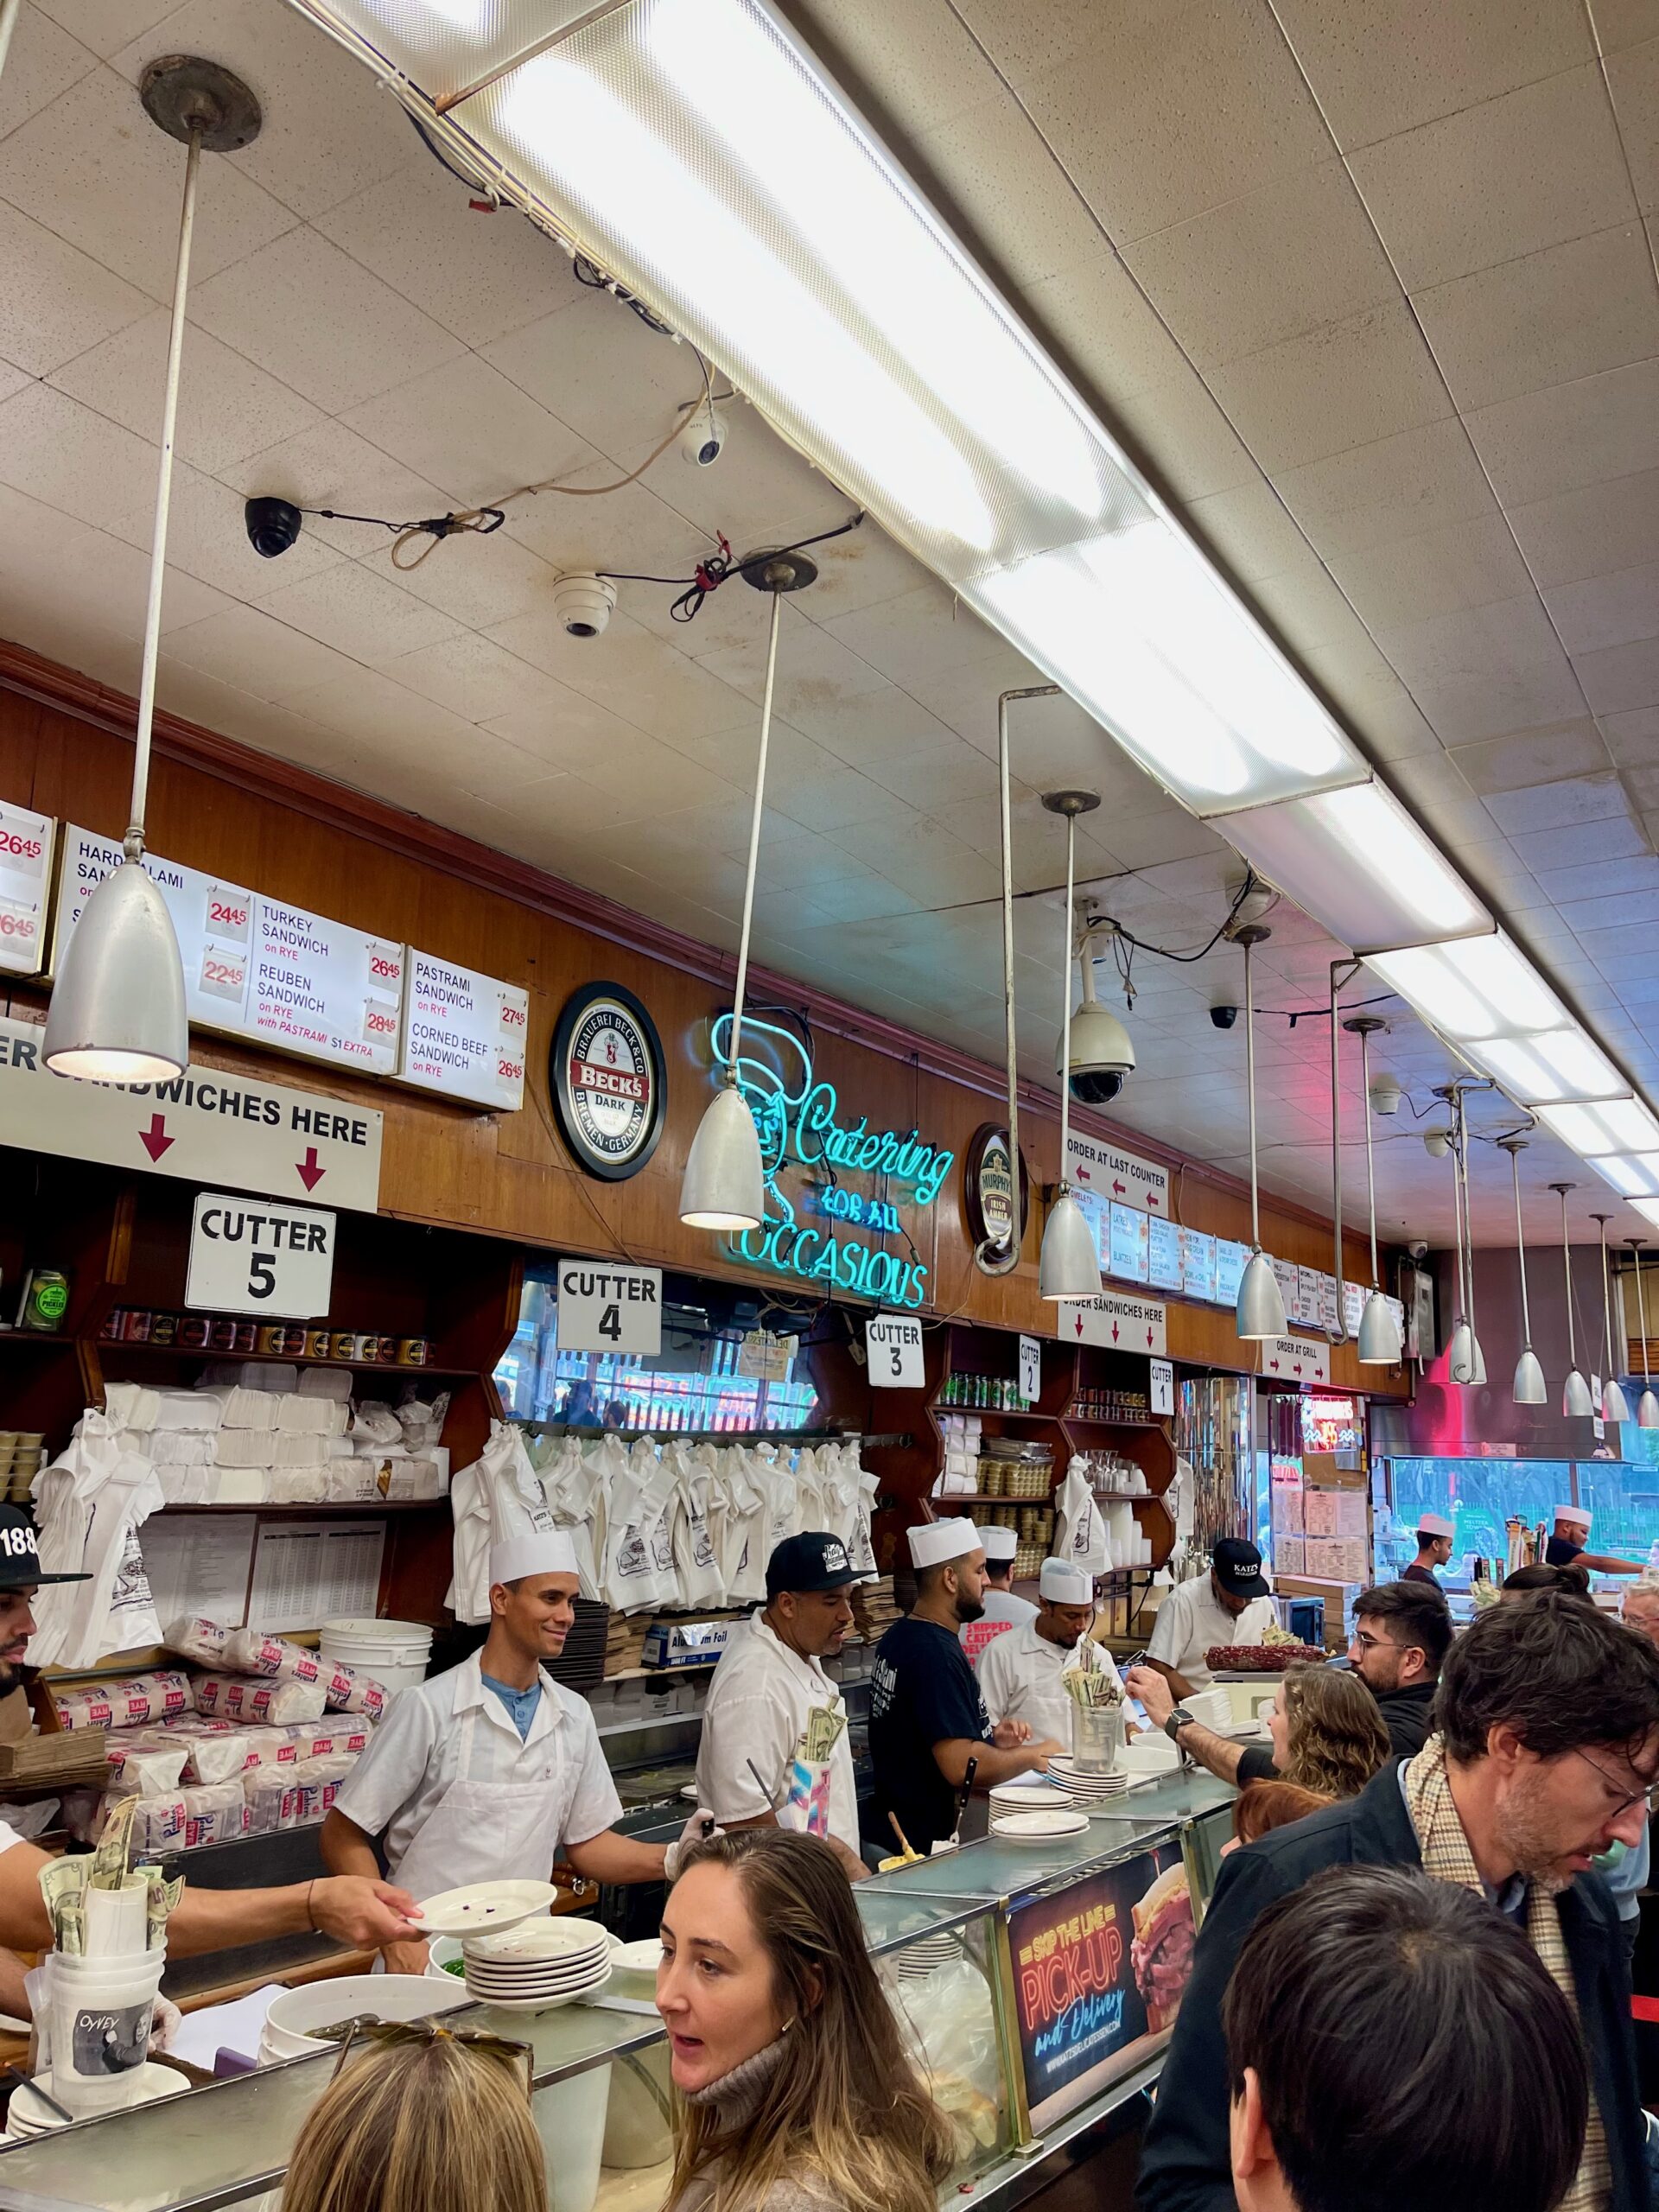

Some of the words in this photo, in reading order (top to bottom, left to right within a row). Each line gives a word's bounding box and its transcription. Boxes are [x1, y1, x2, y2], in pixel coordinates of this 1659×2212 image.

[140, 863, 183, 889] LAMI
[0, 914, 35, 936] 645
[210, 903, 247, 925] 2445
[262, 905, 313, 932] TURKEY
[262, 924, 328, 956] SANDWICH
[264, 944, 276, 954] on
[279, 946, 298, 961] RYE
[204, 961, 243, 984] 2245
[259, 963, 311, 991] REUBEN
[372, 957, 400, 978] 2645
[416, 962, 471, 992] PASTRAMI
[257, 982, 325, 1014] SANDWICH
[415, 981, 473, 1011] SANDWICH
[259, 1002, 271, 1013] on
[274, 1005, 293, 1019] RYE
[417, 1001, 429, 1011] on
[430, 1004, 448, 1017] RYE
[502, 1007, 525, 1025] 2745
[367, 1014, 396, 1032] 2845
[257, 1016, 276, 1028] with
[279, 1021, 327, 1044] PASTRAMI
[343, 1041, 373, 1058] EXTRA
[412, 1022, 459, 1048] CORNED
[461, 1037, 488, 1057] BEEF
[576, 1014, 612, 1059] BRAUEREI
[410, 1040, 469, 1070] SANDWICH
[412, 1061, 423, 1071] on
[425, 1064, 442, 1077] RYE
[499, 1060, 522, 1078] 2645
[594, 1094, 626, 1111] DARK
[291, 1106, 367, 1146] HERE
[576, 1091, 605, 1147] BREMEN
[608, 1103, 644, 1152] GERMANY
[795, 1083, 954, 1205] Catering
[1067, 1138, 1095, 1161] ORDER
[1097, 1151, 1108, 1166] AT
[1109, 1156, 1128, 1173] LAST
[1130, 1165, 1165, 1188] COUNTER
[988, 1209, 1007, 1221] AMBER
[990, 1198, 1006, 1211] IRISH
[200, 1209, 327, 1254] CUTTER
[247, 1251, 276, 1299] 5
[563, 1271, 657, 1303] CUTTER
[1093, 1298, 1142, 1319] SANDWICHES
[1144, 1307, 1163, 1323] HERE
[598, 1304, 621, 1342] 4
[868, 1323, 920, 1345] CUTTER
[1020, 1344, 1039, 1365] CUTTER
[1277, 1340, 1294, 1352] ORDER
[1295, 1344, 1302, 1355] AT
[1303, 1346, 1317, 1358] GRILL
[889, 1346, 902, 1376] 3
[1027, 1365, 1033, 1393] 2
[1151, 1365, 1172, 1383] CUTTER
[1160, 1384, 1165, 1408] 1
[1234, 1563, 1258, 1573] KATZ'S
[713, 1630, 728, 1643] Foil
[263, 1647, 281, 1659] RYE
[298, 1662, 315, 1675] RYE
[333, 1676, 348, 1689] RYE
[130, 1700, 146, 1712] RYE
[168, 1693, 181, 1705] RYE
[366, 1692, 381, 1704] RYE
[92, 1706, 108, 1717] RYE
[278, 1748, 294, 1759] RYE
[187, 1822, 195, 1846] RYE
[1033, 1929, 1057, 1961] SKIP
[1057, 1916, 1081, 1948] THE
[1081, 1905, 1106, 1937] LINE
[1022, 1926, 1122, 2031] PICK-UP
[1035, 2008, 1063, 2056] and
[1061, 1989, 1126, 2040] Delivery
